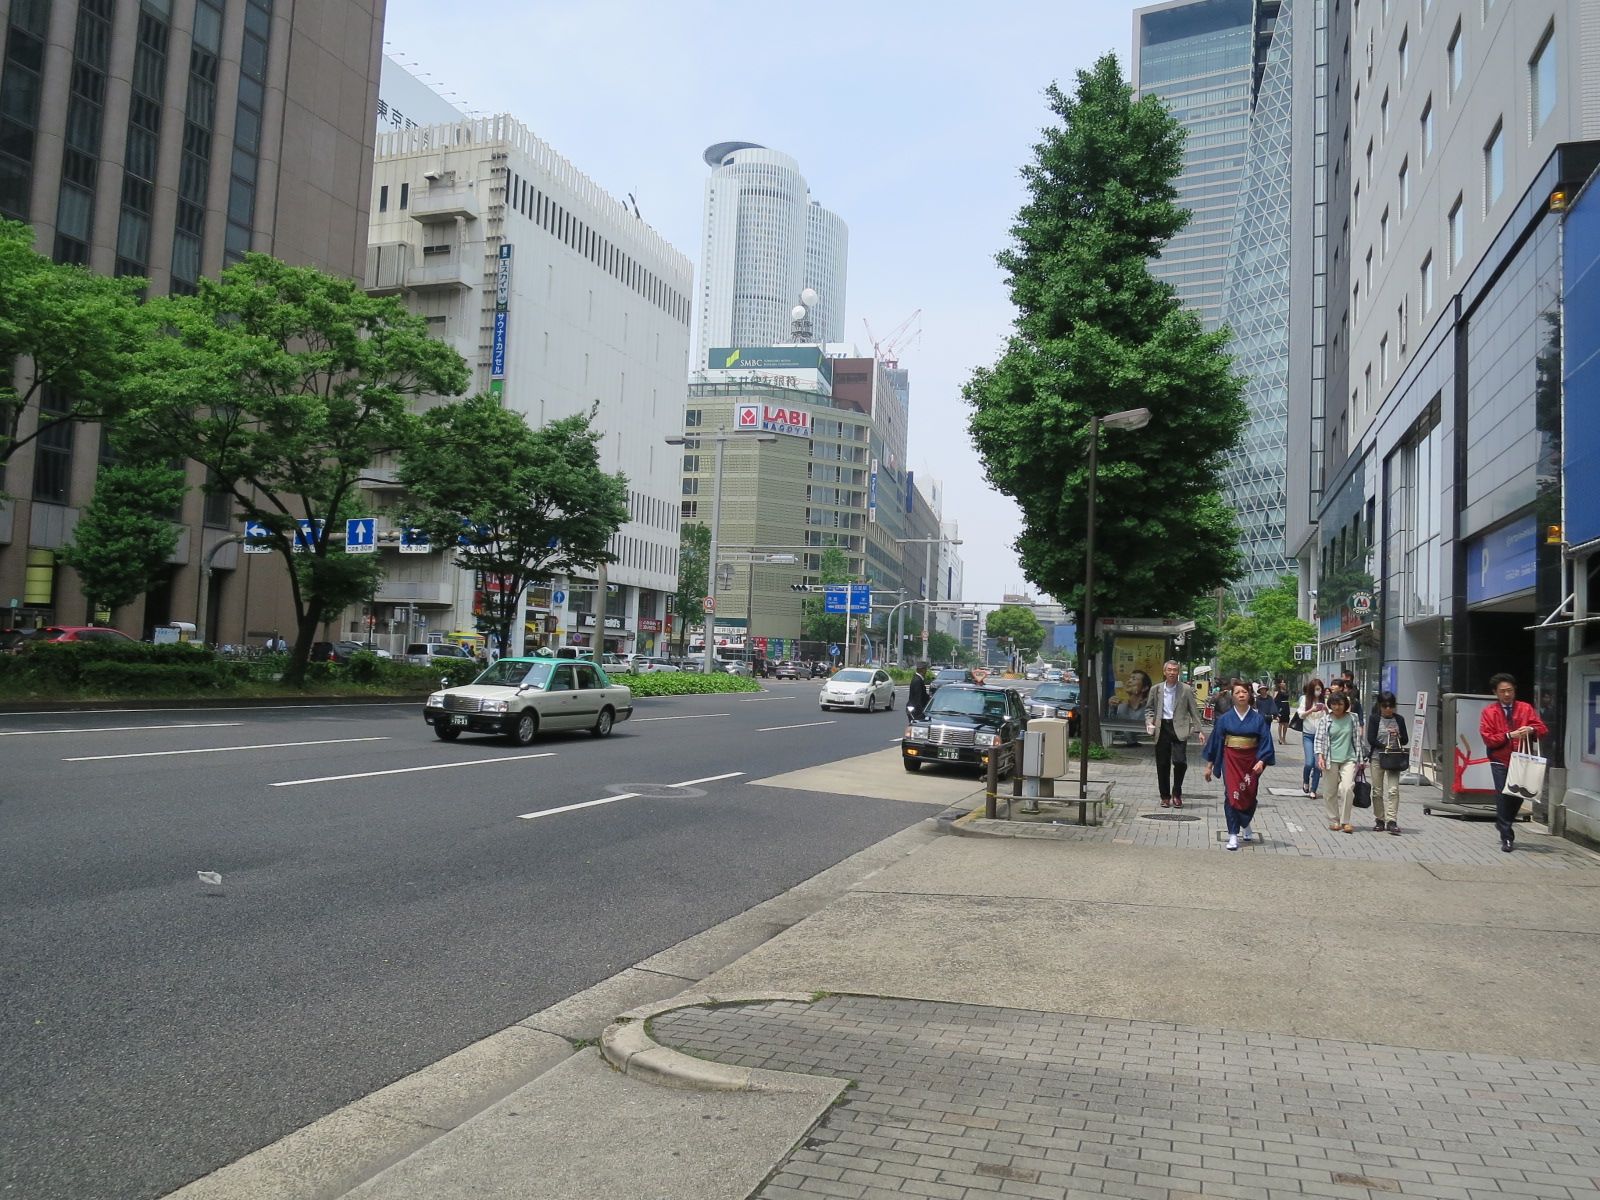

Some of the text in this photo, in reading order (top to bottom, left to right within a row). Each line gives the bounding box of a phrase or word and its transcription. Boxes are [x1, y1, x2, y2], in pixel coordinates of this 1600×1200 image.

[740, 359, 763, 367] SMBC
[763, 405, 808, 427] LABI
[763, 421, 809, 436] NAGOYA
